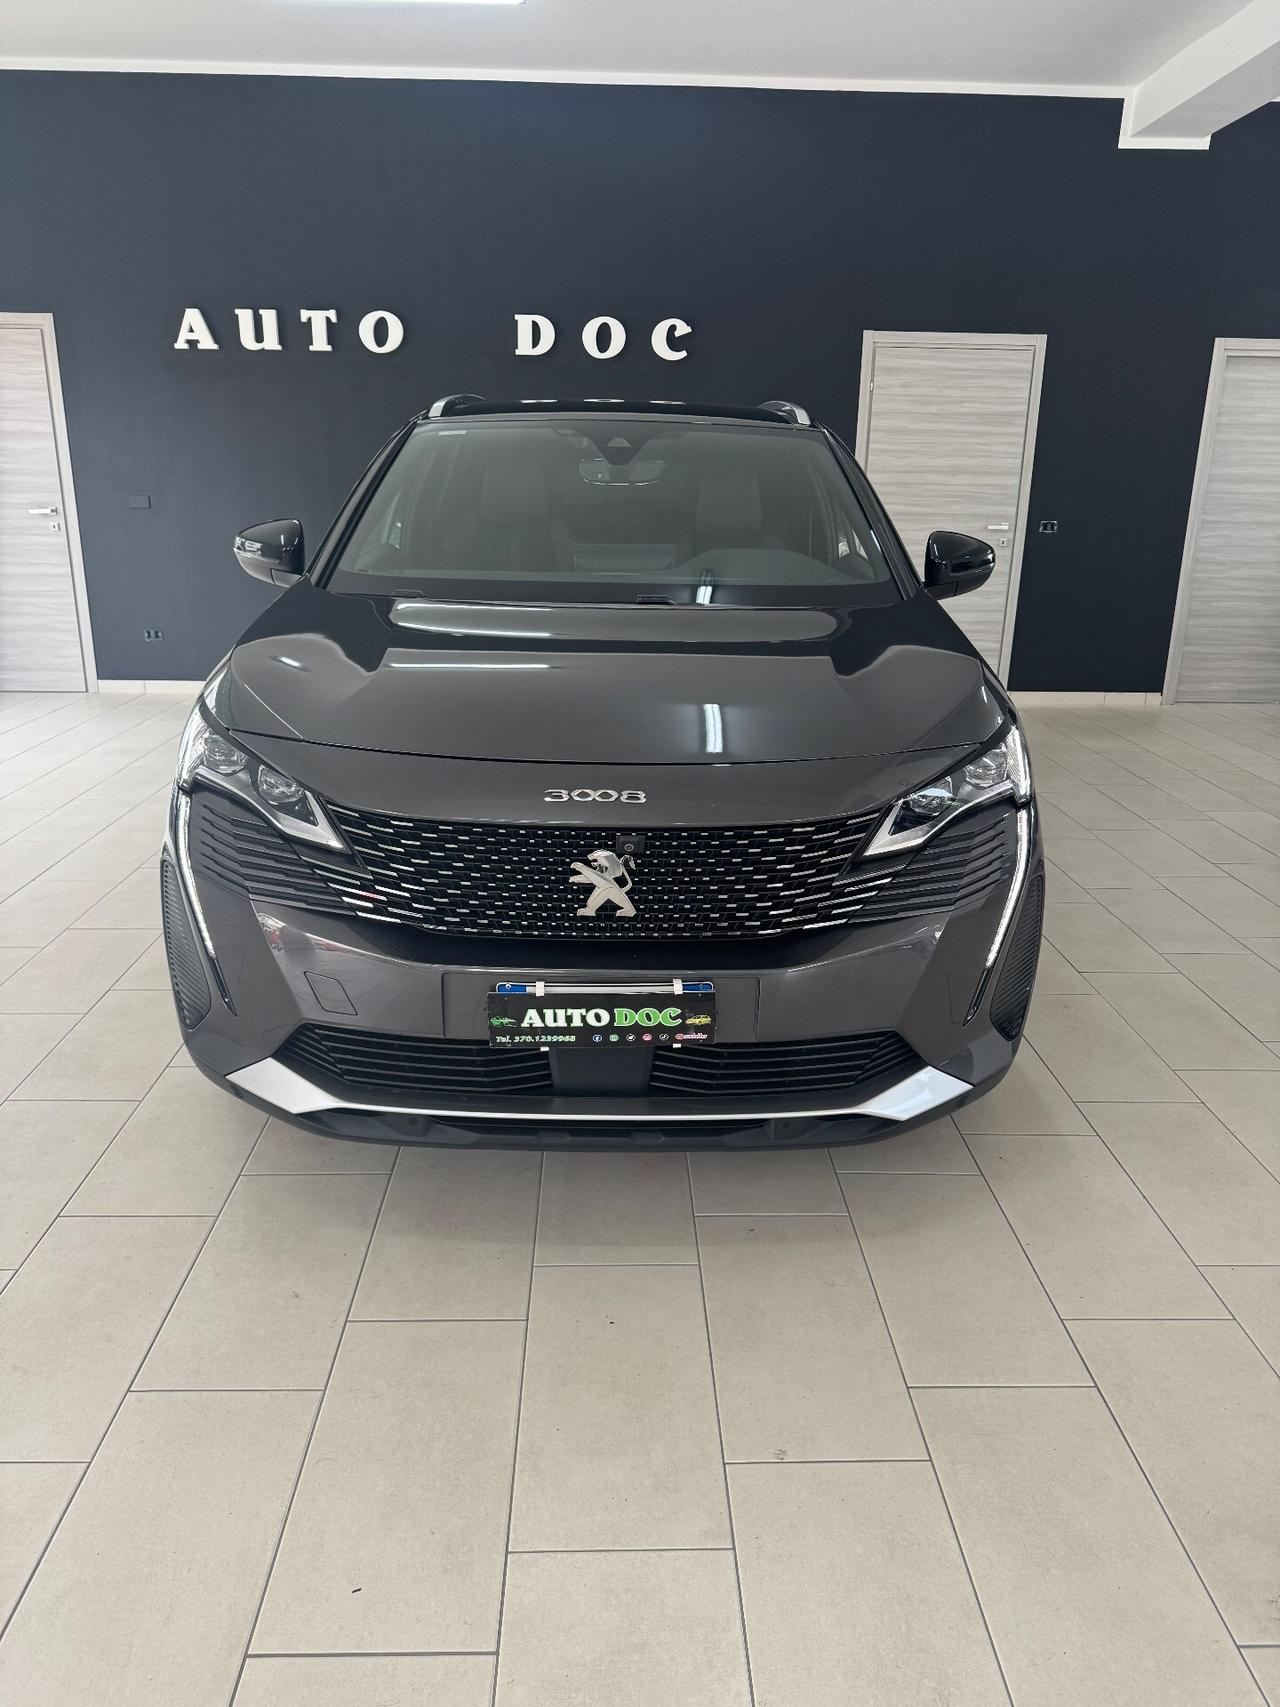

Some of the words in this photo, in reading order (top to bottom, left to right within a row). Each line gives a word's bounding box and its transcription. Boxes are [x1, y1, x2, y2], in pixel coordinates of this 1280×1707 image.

[174, 308, 404, 354] AUTO
[514, 314, 692, 361] DOC
[544, 789, 646, 803] 3008
[520, 1008, 610, 1027] AUTO
[614, 1008, 682, 1027] DOC
